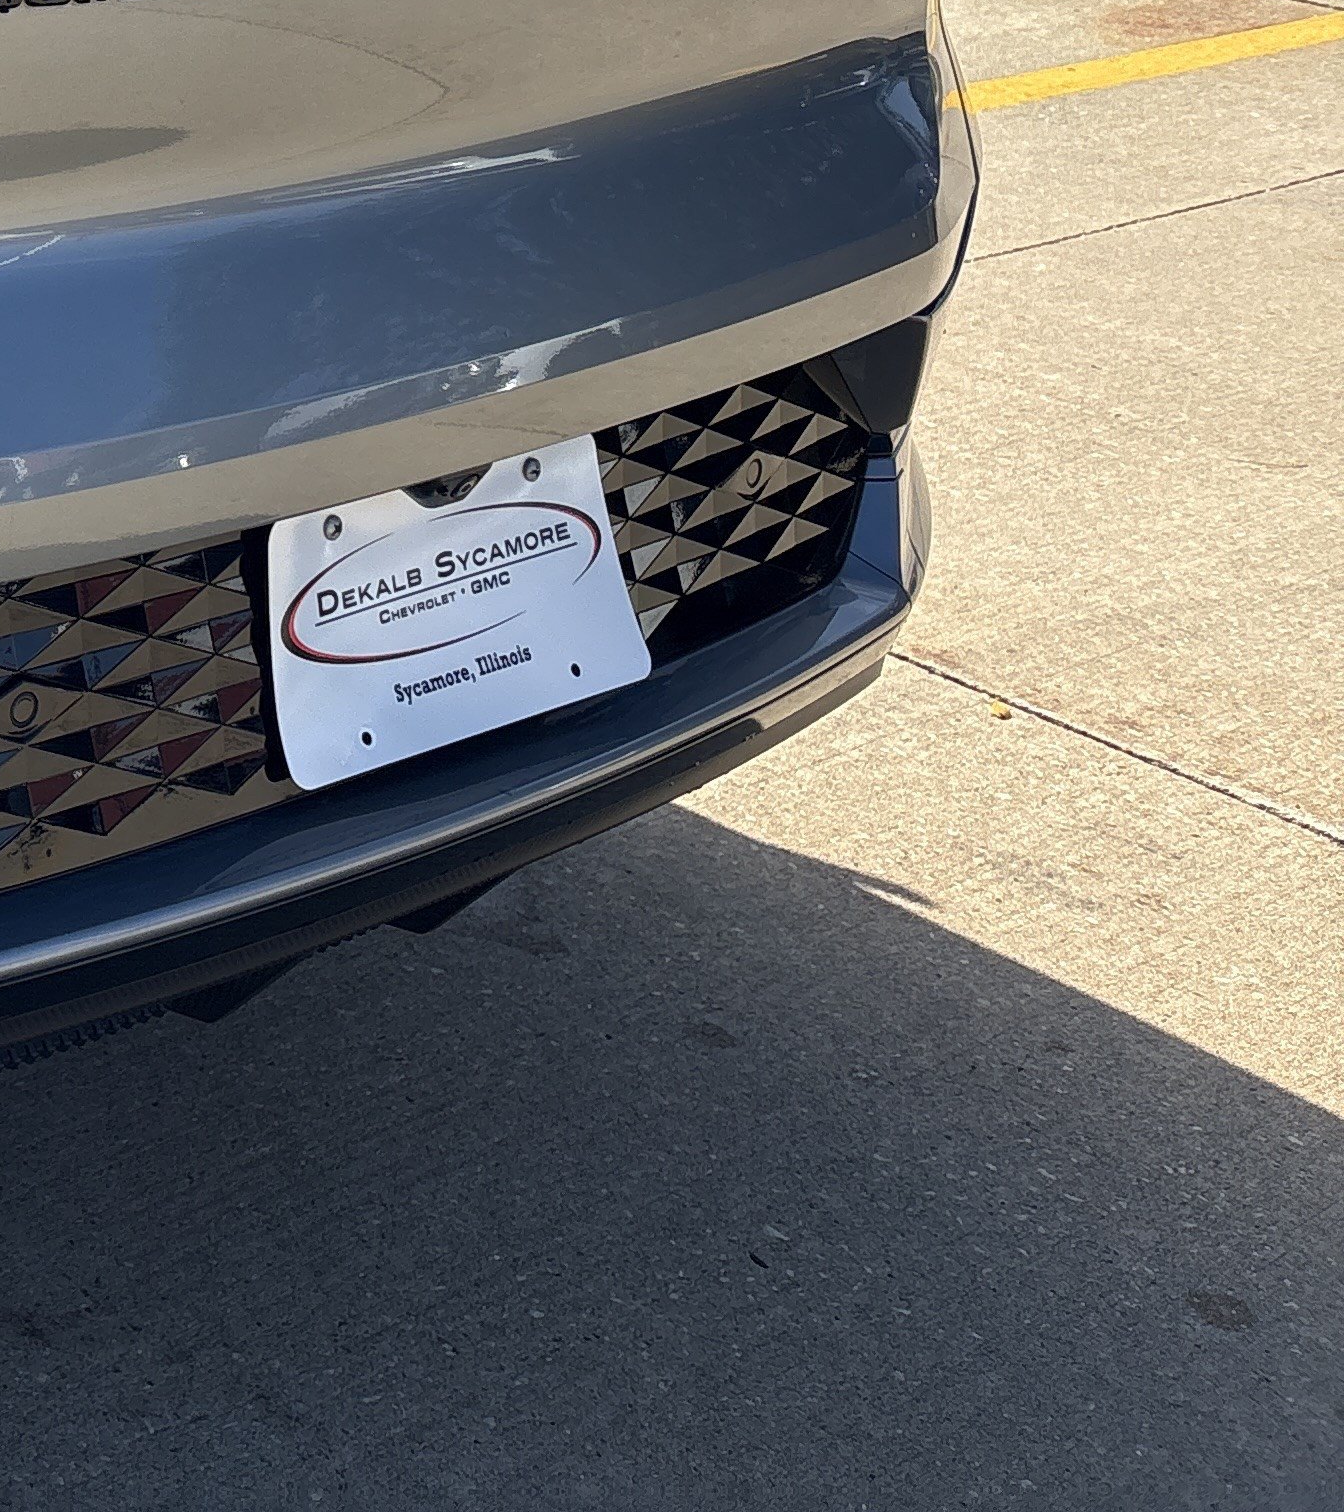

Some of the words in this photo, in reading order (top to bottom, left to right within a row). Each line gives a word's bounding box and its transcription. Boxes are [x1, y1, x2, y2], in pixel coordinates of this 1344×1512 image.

[434, 521, 572, 579] SYCAMORE
[378, 590, 457, 625] CHEVROLET
[470, 570, 511, 595] GMC
[393, 667, 477, 705] Sycamore,
[474, 644, 532, 677] Illinois
